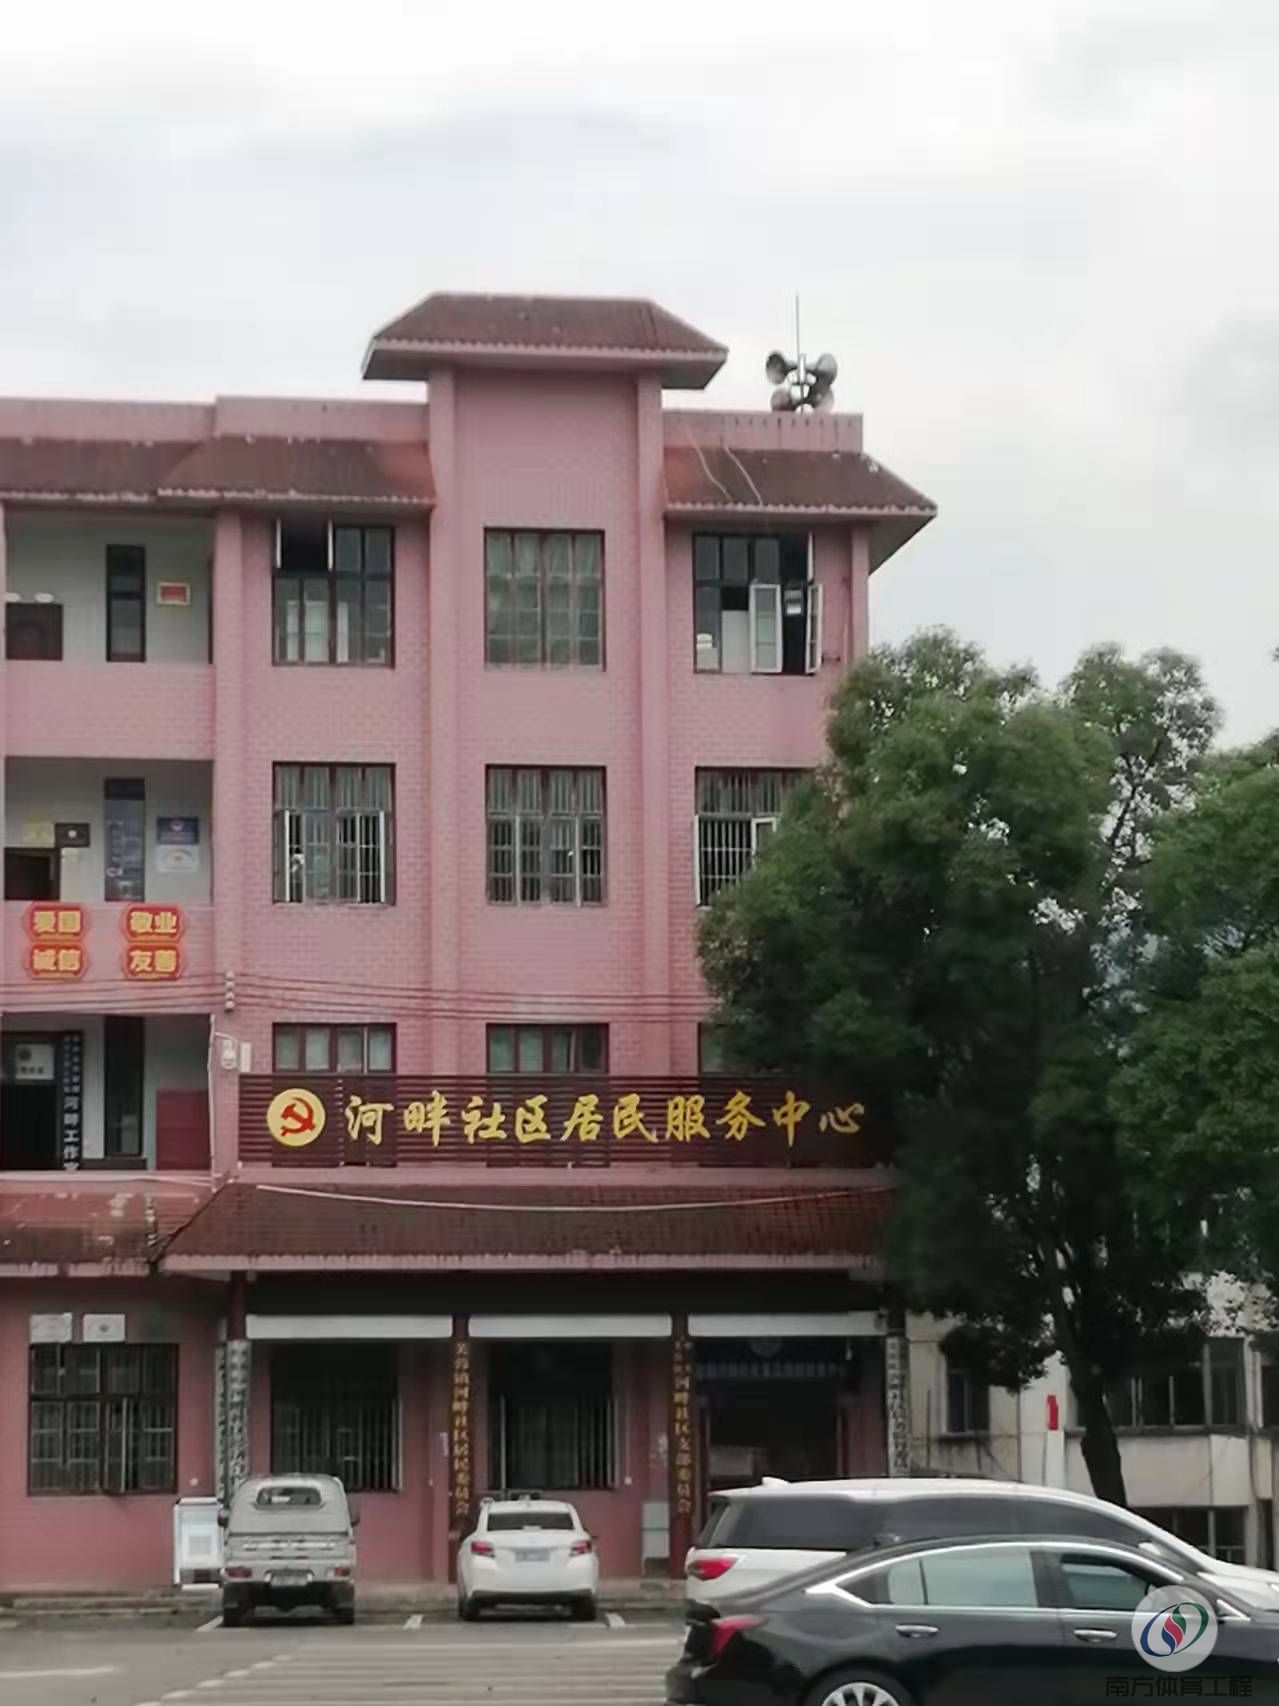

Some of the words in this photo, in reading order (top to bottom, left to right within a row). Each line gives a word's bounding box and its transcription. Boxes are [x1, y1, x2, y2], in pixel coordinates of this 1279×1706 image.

[345, 1089, 865, 1147] 河畔社区居民服务中心
